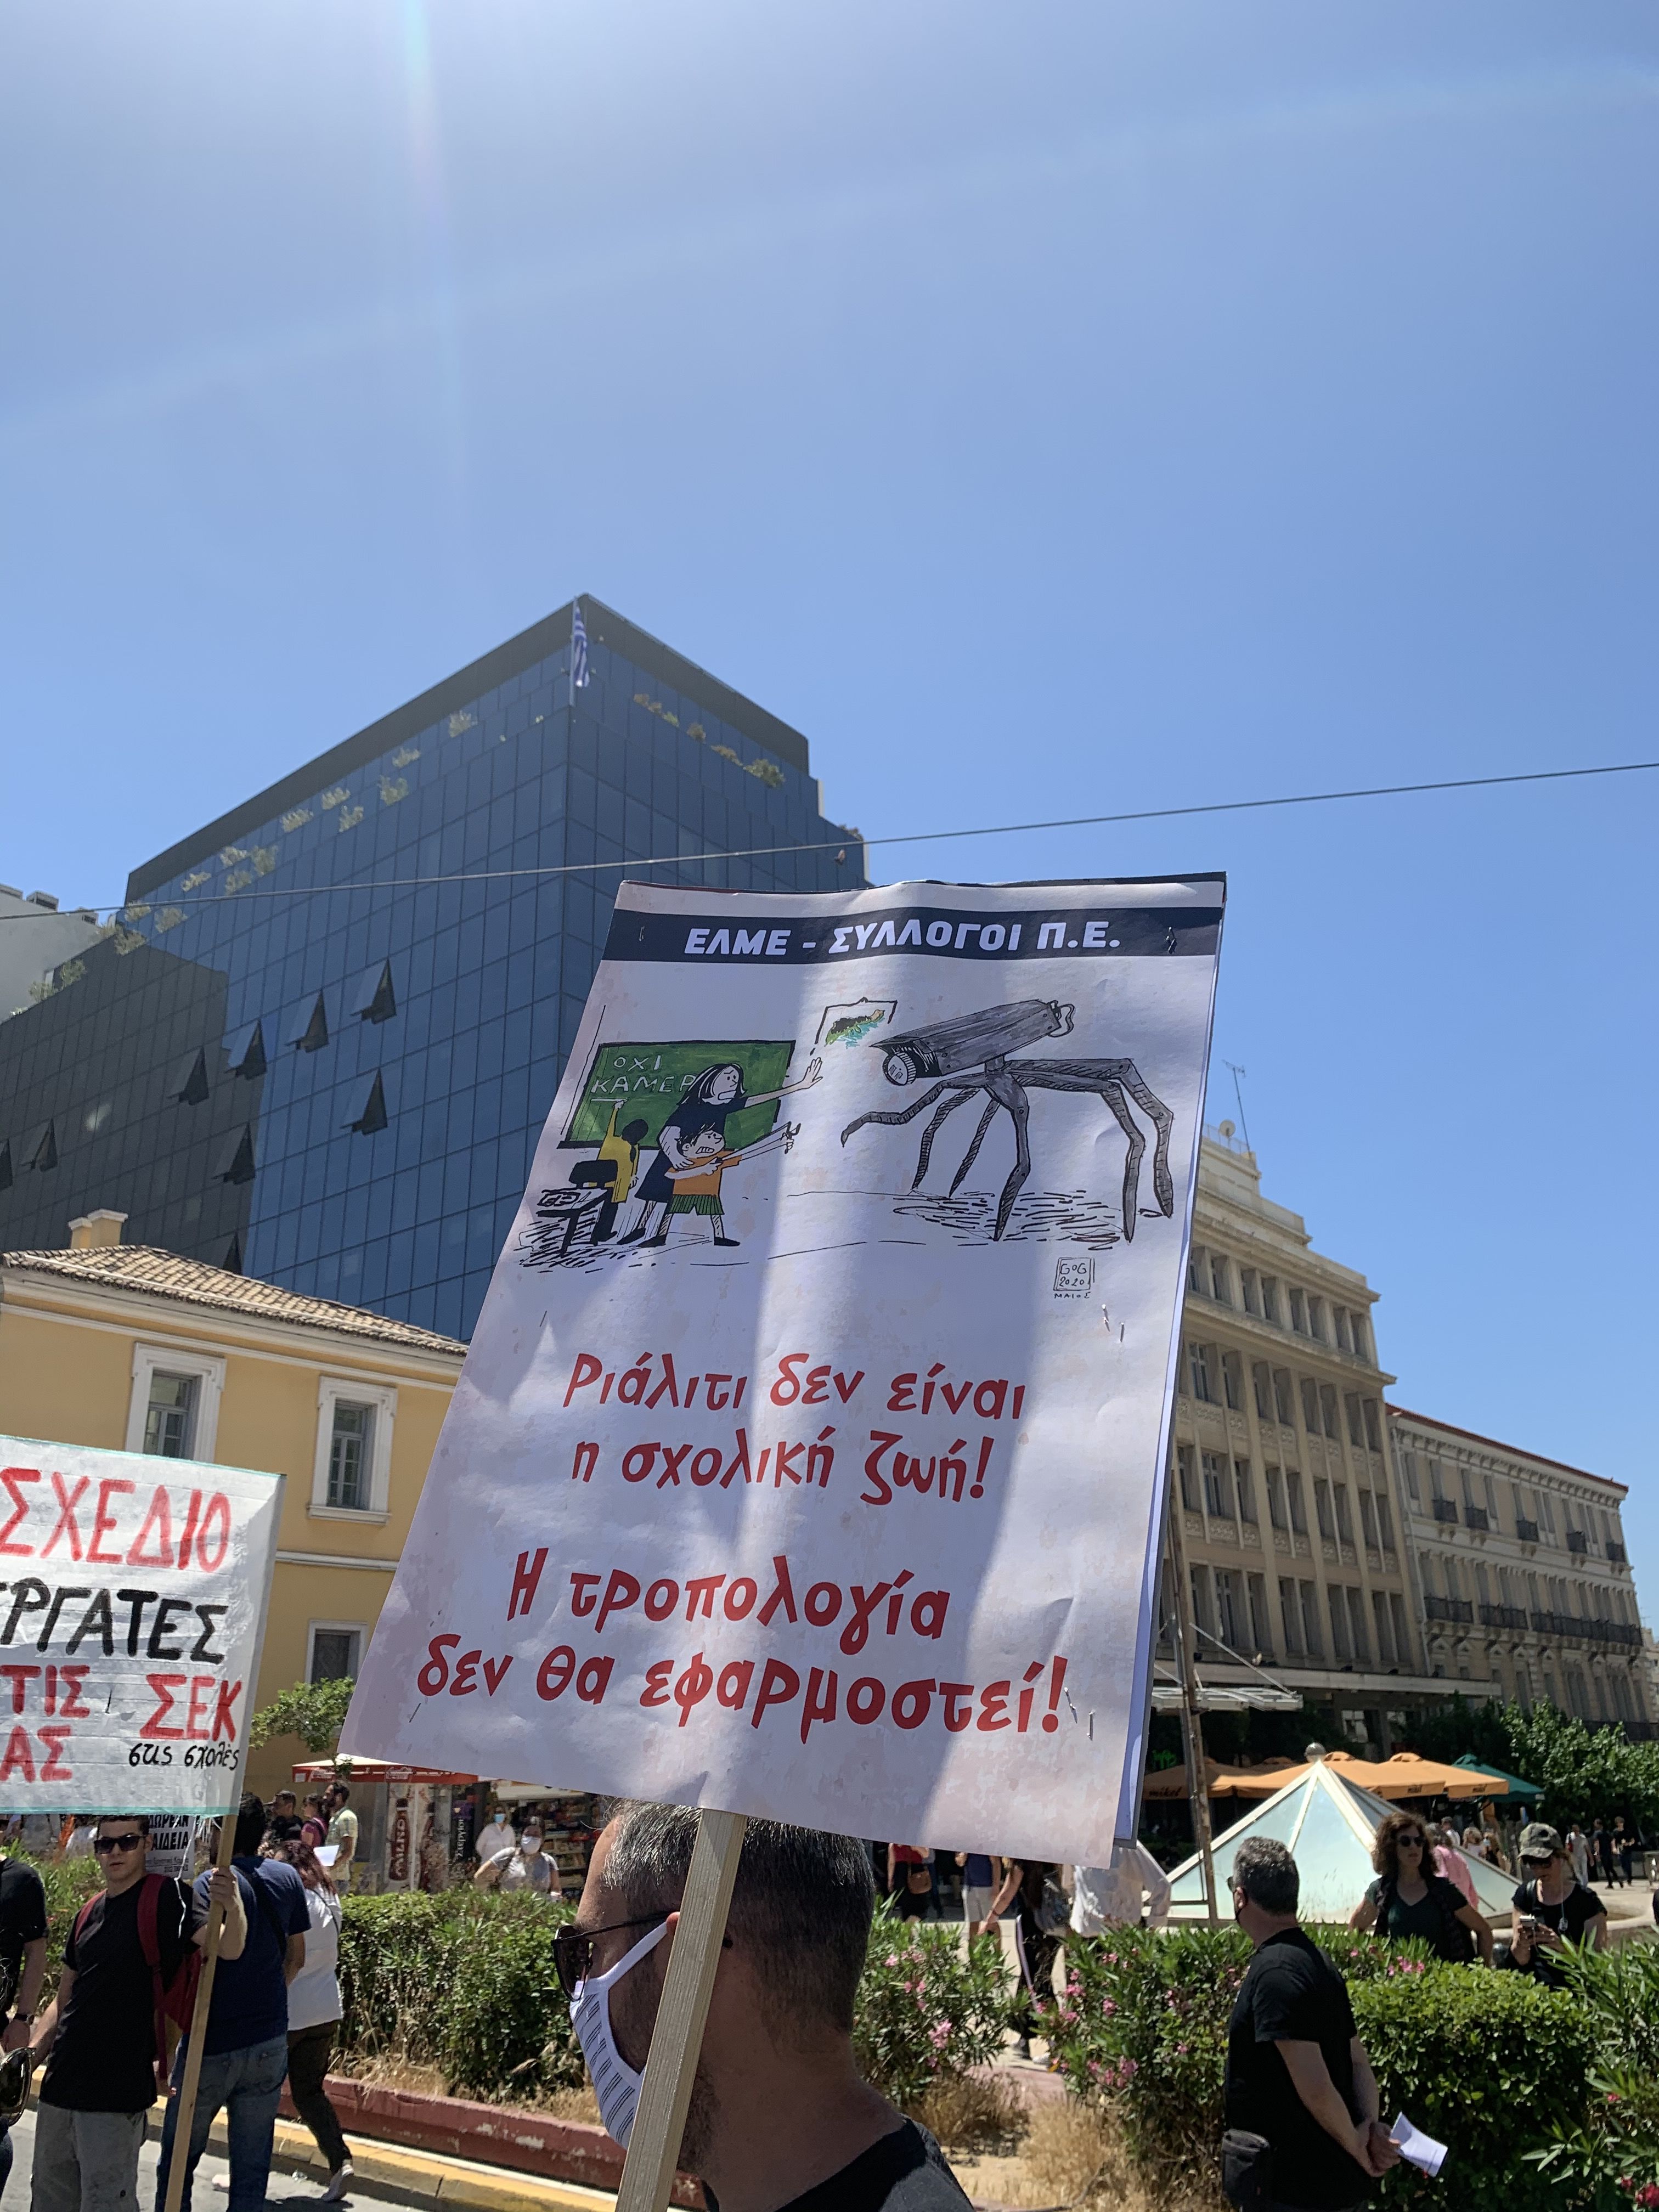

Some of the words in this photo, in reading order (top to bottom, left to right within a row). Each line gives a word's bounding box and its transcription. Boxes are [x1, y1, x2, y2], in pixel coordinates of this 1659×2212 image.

[684, 928, 791, 955] ΕΛΜΕ
[828, 919, 1022, 954] ΣΥΛΛΟΓΟΙ
[1036, 921, 1120, 950] Π.Ε.
[613, 1054, 662, 1072] ΟΧΙ
[1059, 1276, 1085, 1287] 2020
[564, 1352, 747, 1409] Ριάλιτι
[770, 1353, 864, 1407] δεν
[888, 1363, 1025, 1419] είναι
[572, 1441, 598, 1482] η
[623, 1426, 835, 1488] σχολική
[861, 1430, 993, 1505] ζωή!
[0, 1467, 231, 1572] ΣΧΕΔΙΟ
[0, 1577, 228, 1664] ΡΓΑΤΕΣ
[508, 1548, 548, 1620] Η
[569, 1556, 950, 1654] τροπολογία
[0, 1664, 91, 1719] ΤΙΣ
[140, 1673, 242, 1742] ΣΕΚ
[418, 1634, 512, 1696] δεν
[537, 1646, 614, 1704] θα
[640, 1651, 1067, 1742] εφαρμοστεί!
